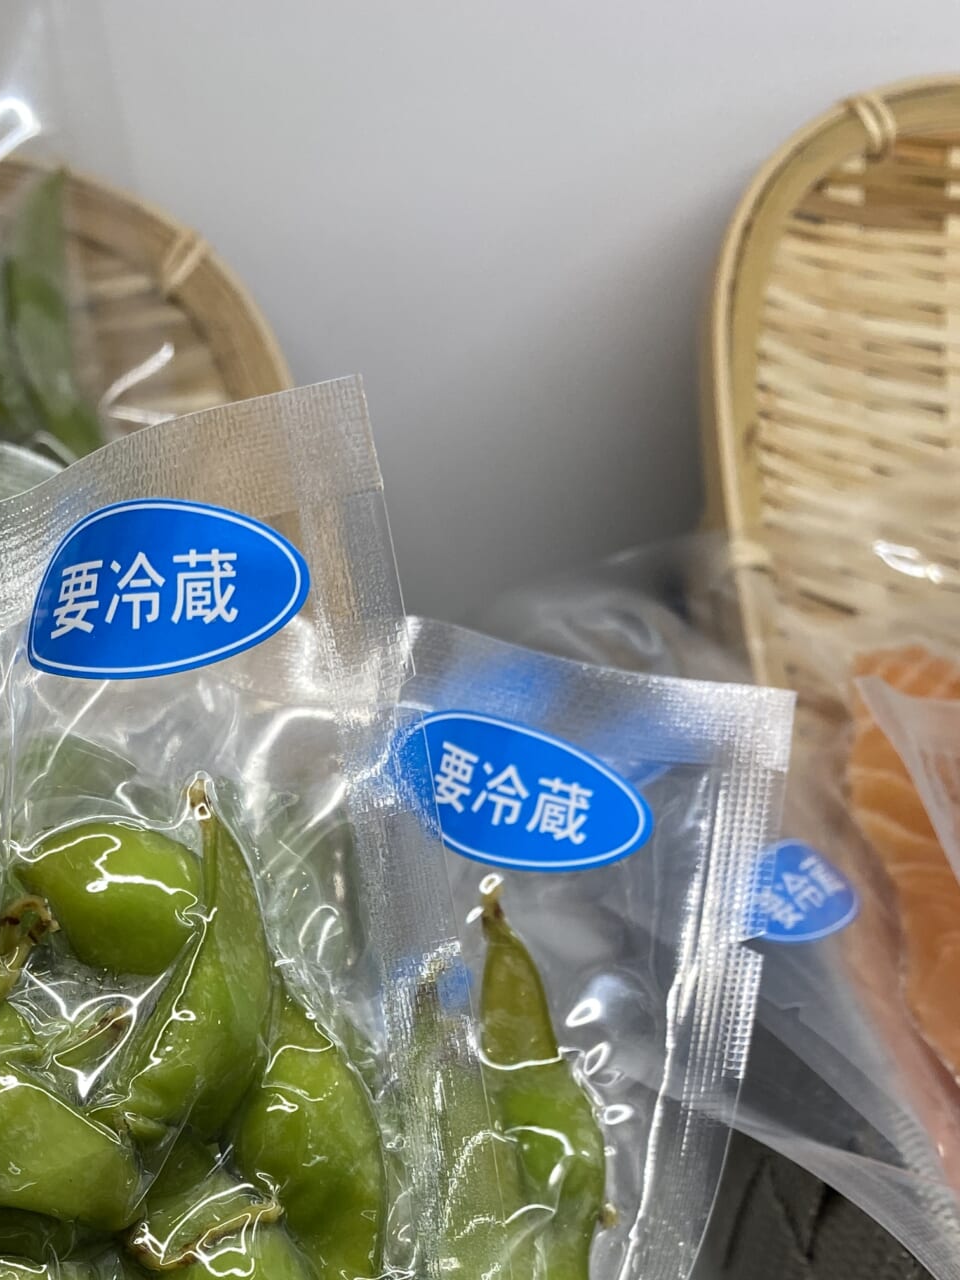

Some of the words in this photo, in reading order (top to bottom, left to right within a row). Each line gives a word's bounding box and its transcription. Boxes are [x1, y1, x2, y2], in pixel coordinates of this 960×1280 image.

[51, 549, 239, 640] 要冷蔵
[435, 741, 593, 845] 要冷蔵
